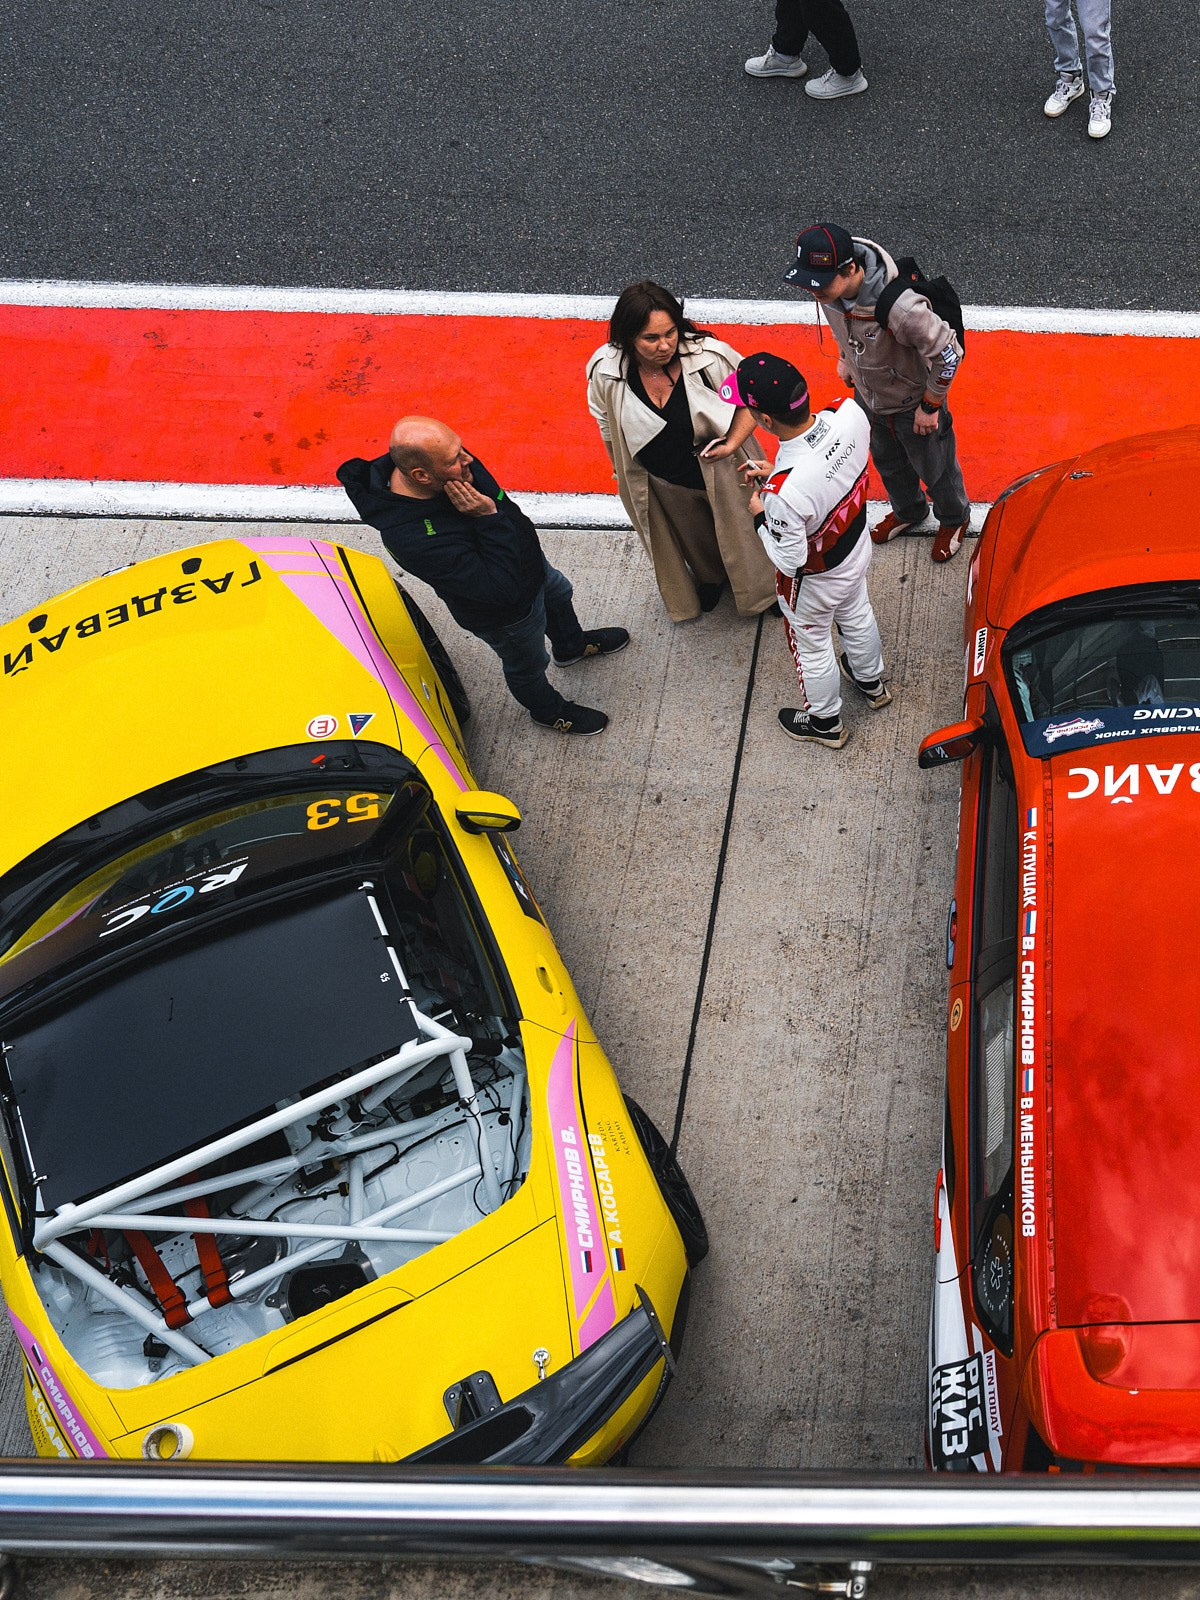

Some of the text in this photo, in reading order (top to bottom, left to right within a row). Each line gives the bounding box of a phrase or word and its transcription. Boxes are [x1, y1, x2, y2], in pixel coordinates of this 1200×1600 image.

[825, 439, 856, 482] SMIRNOV
[977, 629, 987, 660] HAWK
[1094, 729, 1136, 740] гонок
[306, 792, 380, 831] 53
[1023, 830, 1037, 908] К.ГЛУШАК
[1021, 936, 1036, 1065] В. СМИРНОВ
[596, 1120, 608, 1142] AZDA
[1020, 1097, 1036, 1237] В.МЕНЬШИКОВ
[560, 1125, 594, 1249] СМИРНОВ В.
[588, 1133, 623, 1244] А.КОСАРЕВ
[41, 1366, 95, 1459] СМИРНОВ
[941, 1364, 969, 1456] ЖИЗ
[966, 1357, 983, 1432] РГС
[986, 1355, 1000, 1433] MEN TODAY
